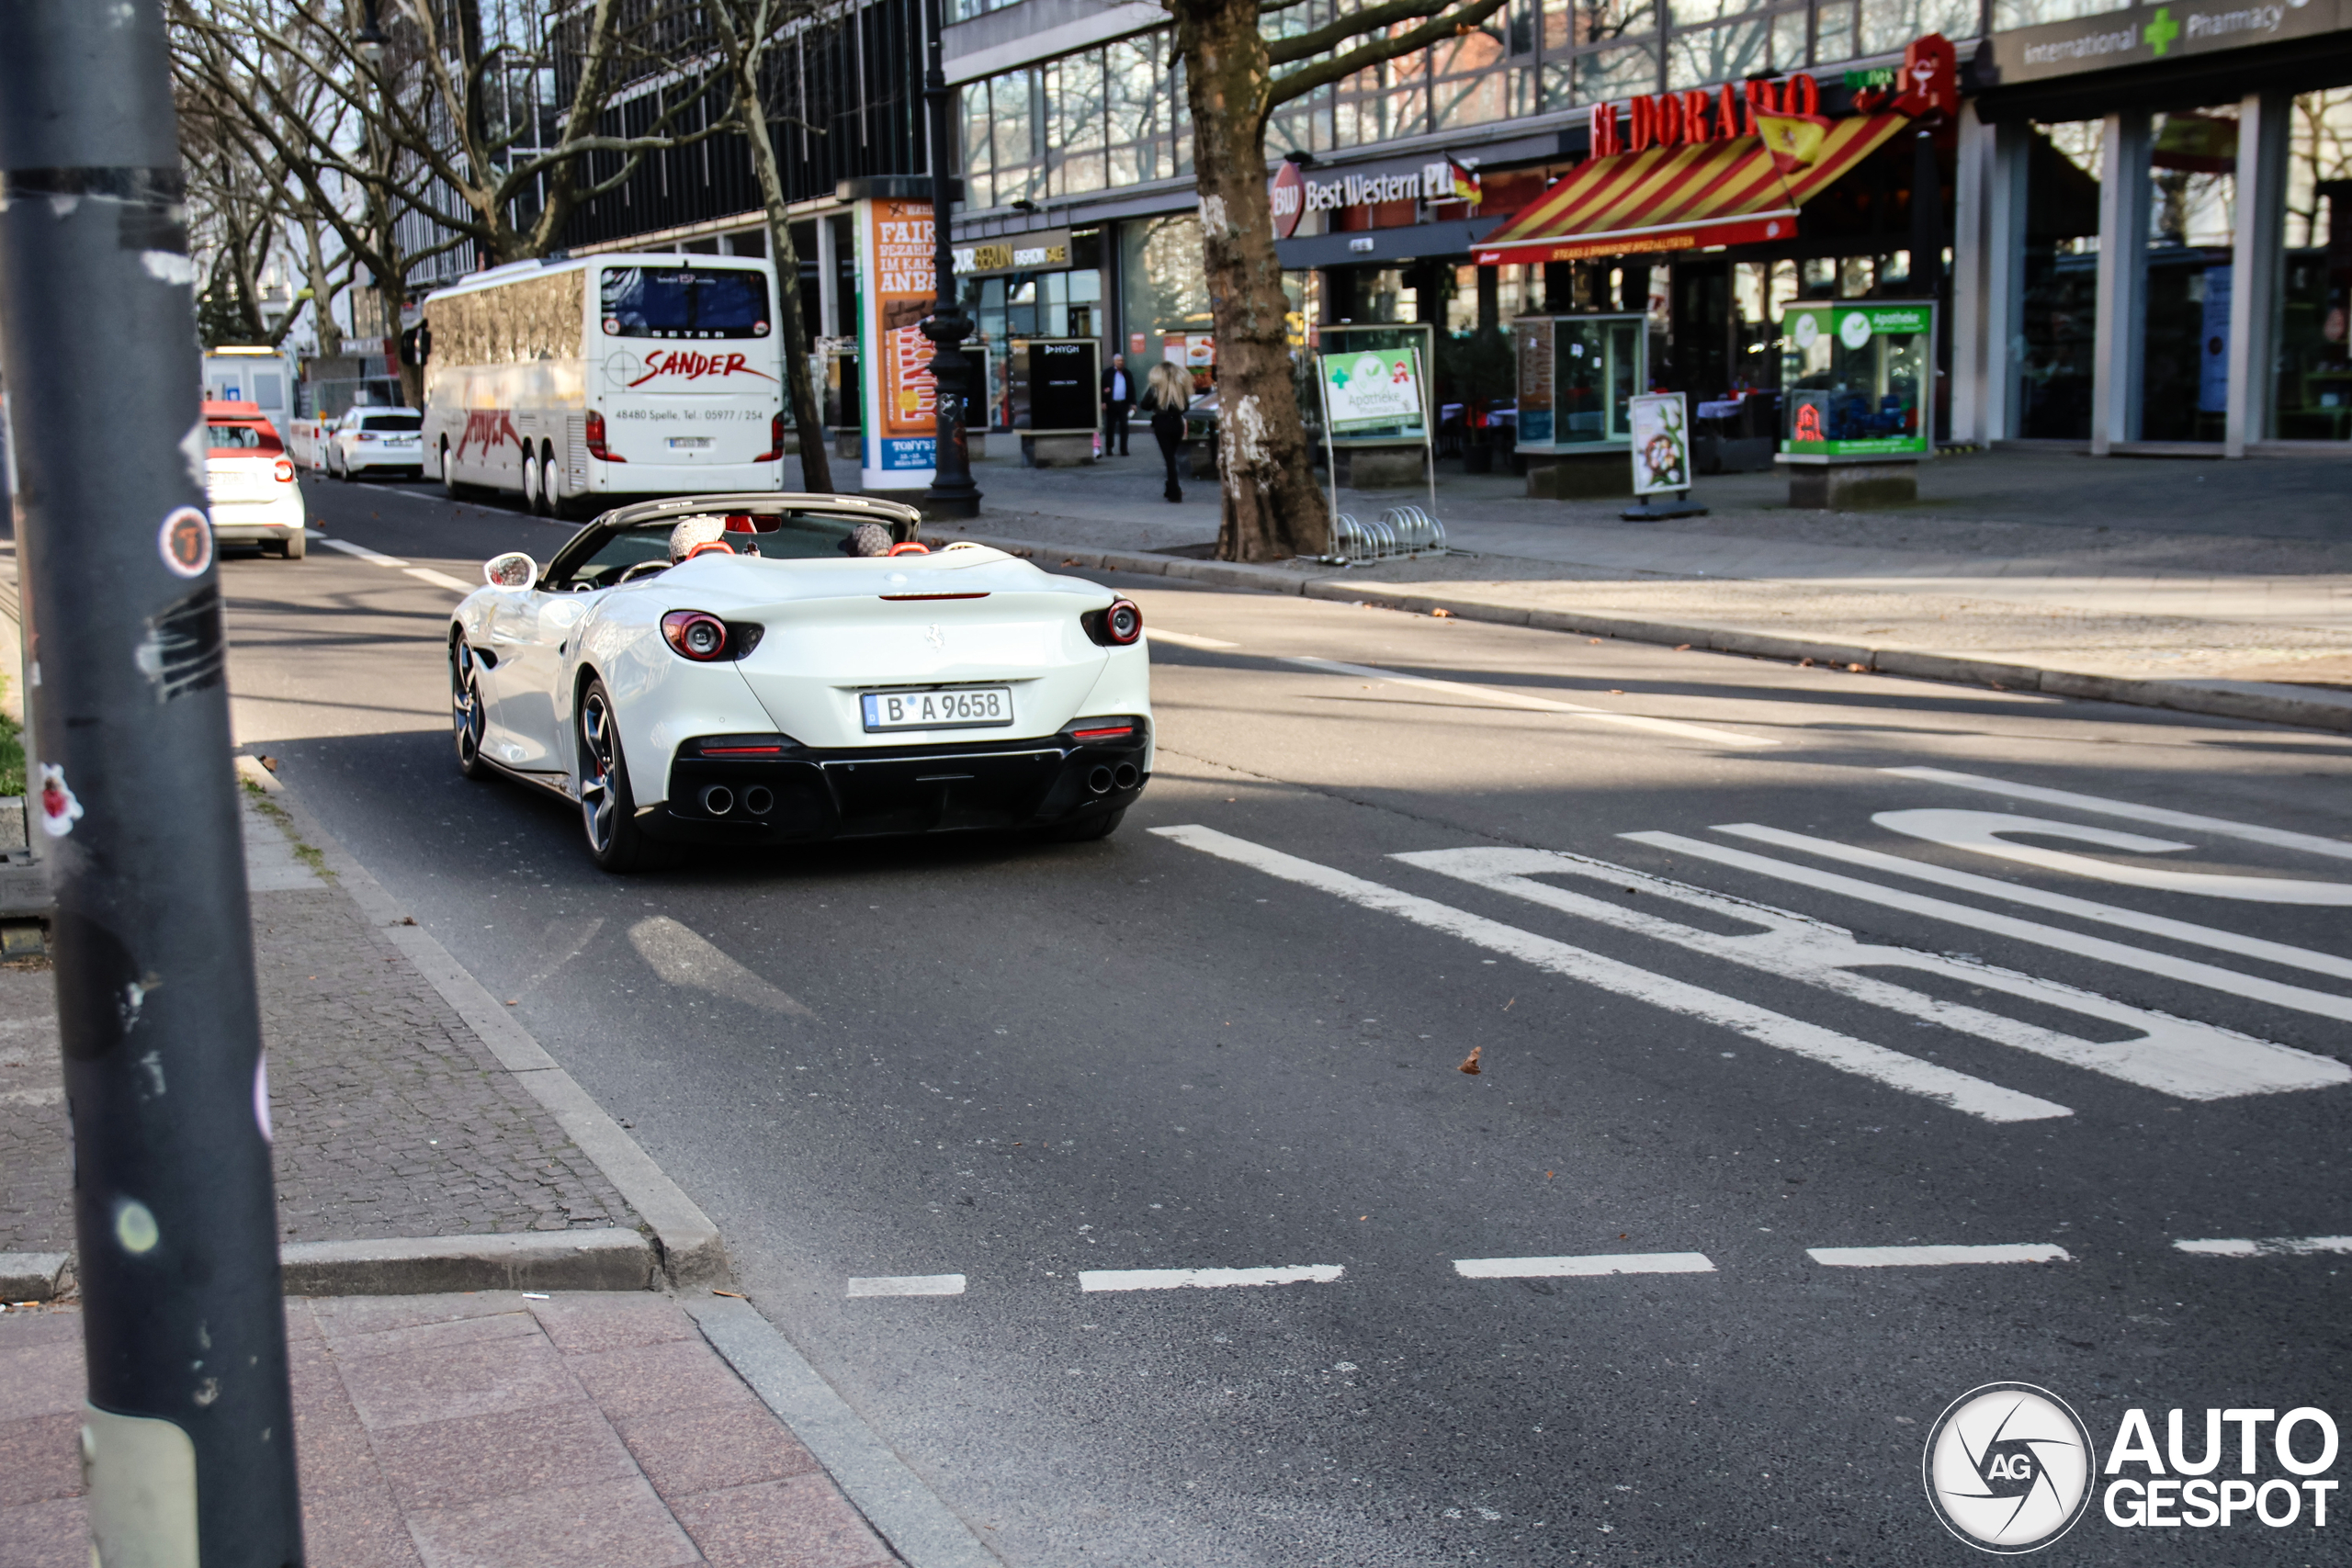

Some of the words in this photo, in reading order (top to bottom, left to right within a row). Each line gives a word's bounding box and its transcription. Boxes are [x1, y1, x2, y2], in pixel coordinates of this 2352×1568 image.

[2187, 5, 2286, 41] Pharmacy
[1590, 102, 1624, 160] EL
[1630, 73, 1820, 152] DORADO
[1273, 185, 1298, 217] BW
[1305, 179, 1343, 212] Best
[1344, 172, 1420, 207] Western
[879, 258, 899, 271] IM
[975, 243, 1013, 271] BERLIN
[1013, 247, 1046, 267] FASHION
[1046, 245, 1066, 263] SALE
[1054, 344, 1080, 354] HYGH
[627, 349, 780, 388] SANDER
[1349, 390, 1400, 410] Apotheke
[616, 410, 647, 420] 48480
[650, 410, 681, 422] Spelle,
[706, 410, 735, 420] 05977
[746, 410, 763, 420] 254
[892, 440, 931, 451] TONY'S
[888, 697, 904, 721] B
